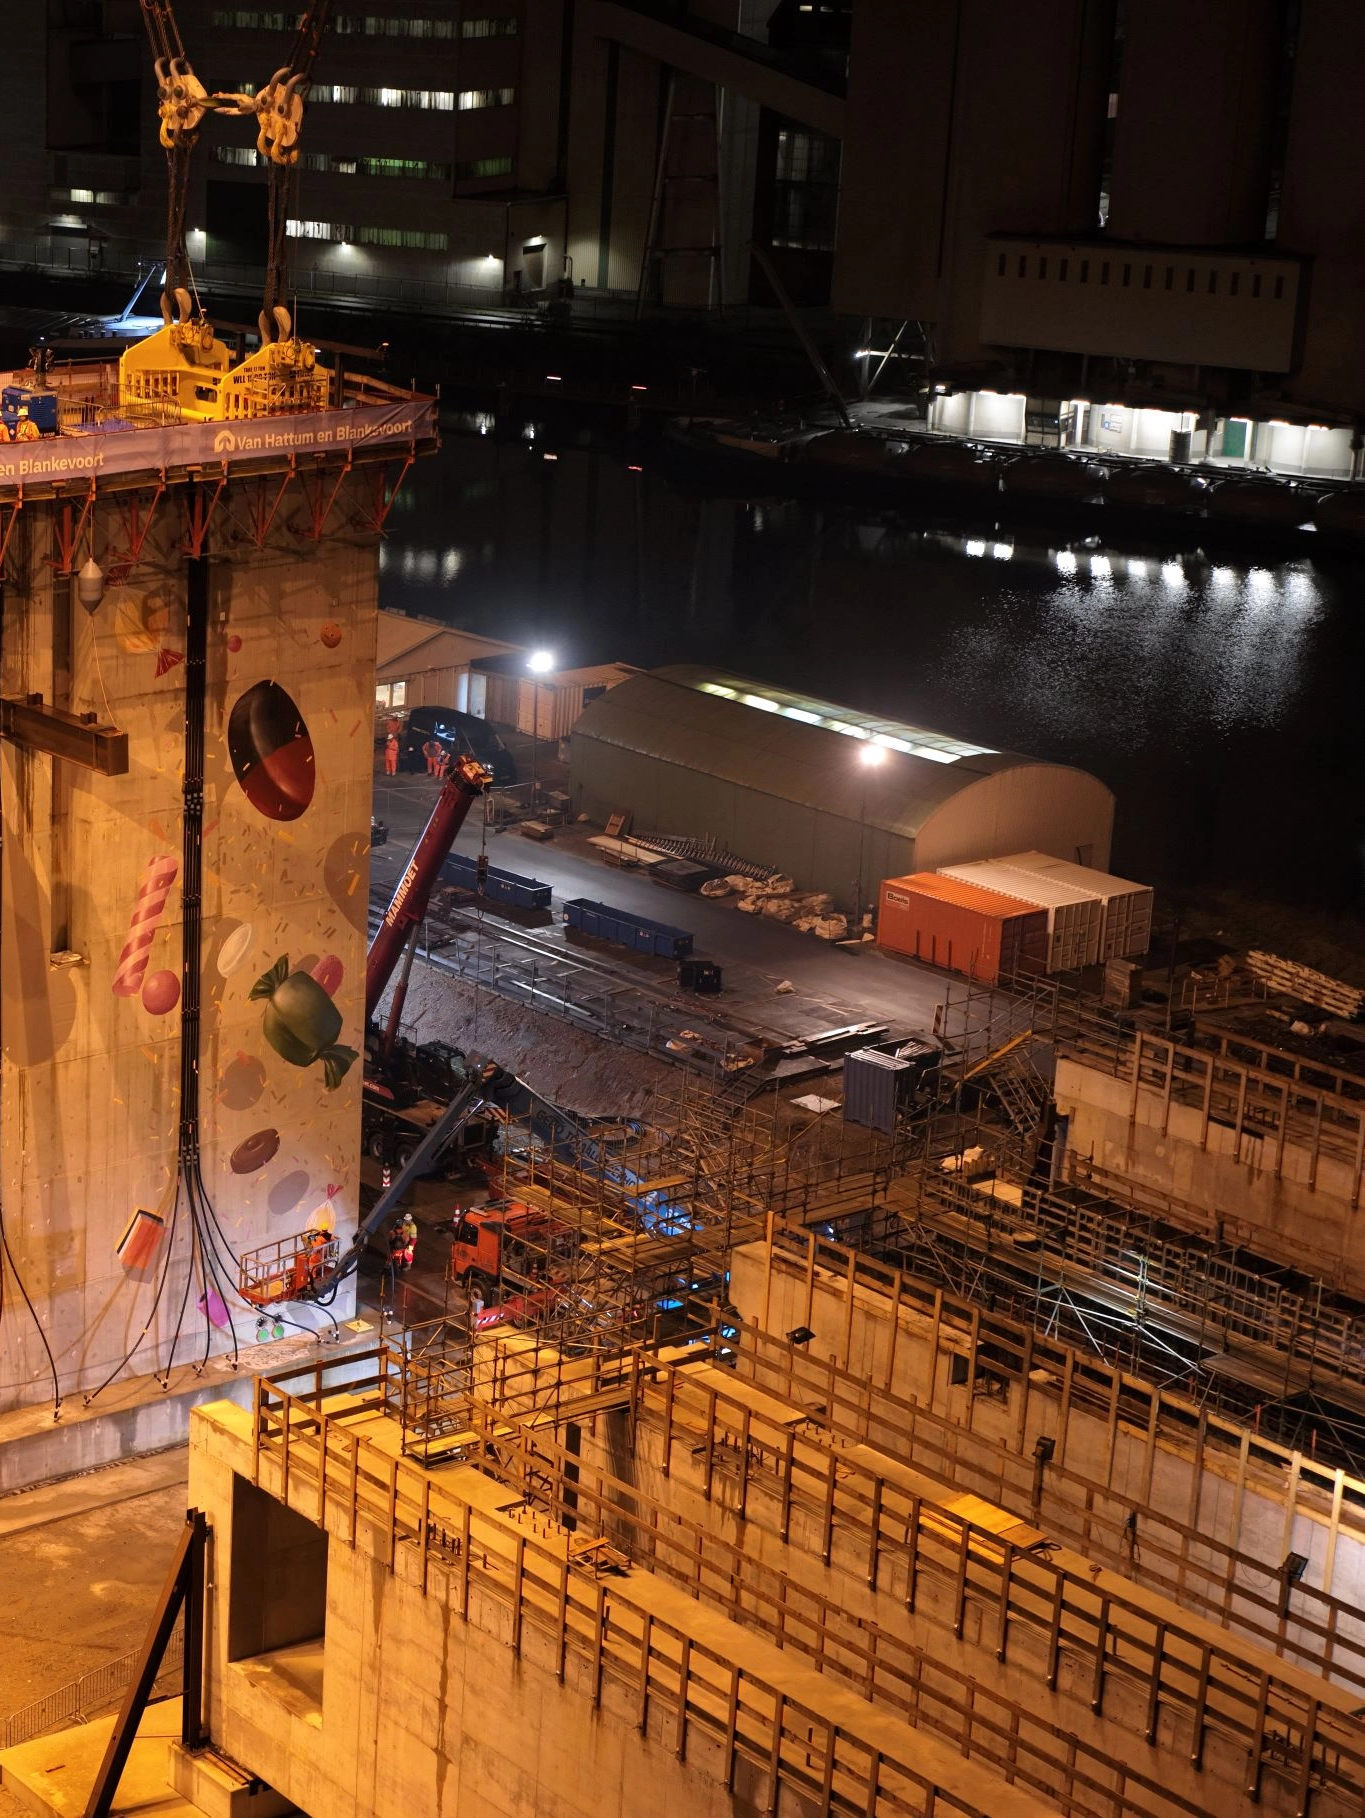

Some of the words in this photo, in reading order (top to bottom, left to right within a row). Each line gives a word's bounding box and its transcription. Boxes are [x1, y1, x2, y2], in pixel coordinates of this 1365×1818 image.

[237, 435, 262, 450] Van
[265, 432, 315, 449] Hattum
[317, 430, 333, 442] en
[336, 419, 413, 441] Blankevoort
[19, 452, 104, 475] Blankevoort
[385, 858, 419, 928] MAMMOET
[887, 892, 909, 905] Boels
